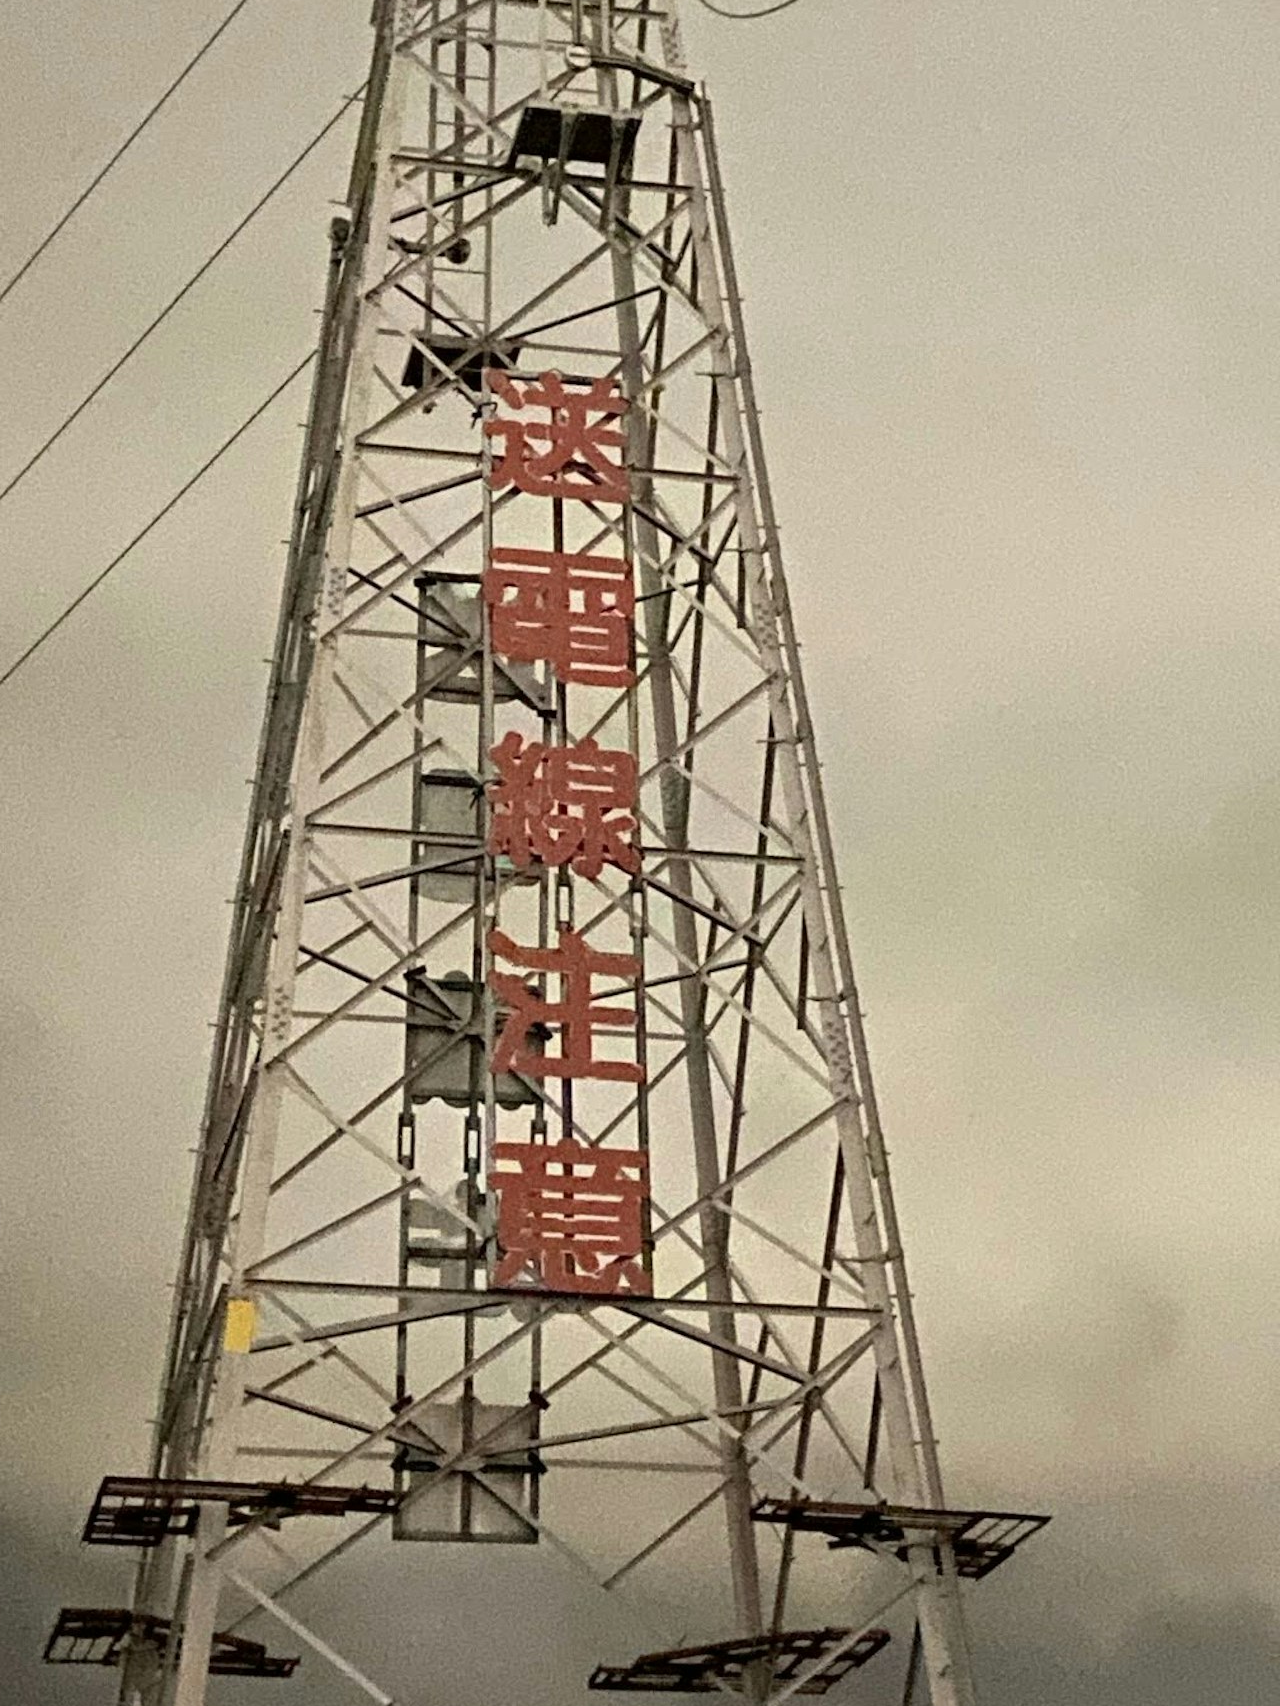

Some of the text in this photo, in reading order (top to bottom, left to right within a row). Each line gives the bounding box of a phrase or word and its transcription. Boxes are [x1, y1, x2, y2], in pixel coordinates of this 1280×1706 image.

[483, 369, 651, 1294] 送電線注意
